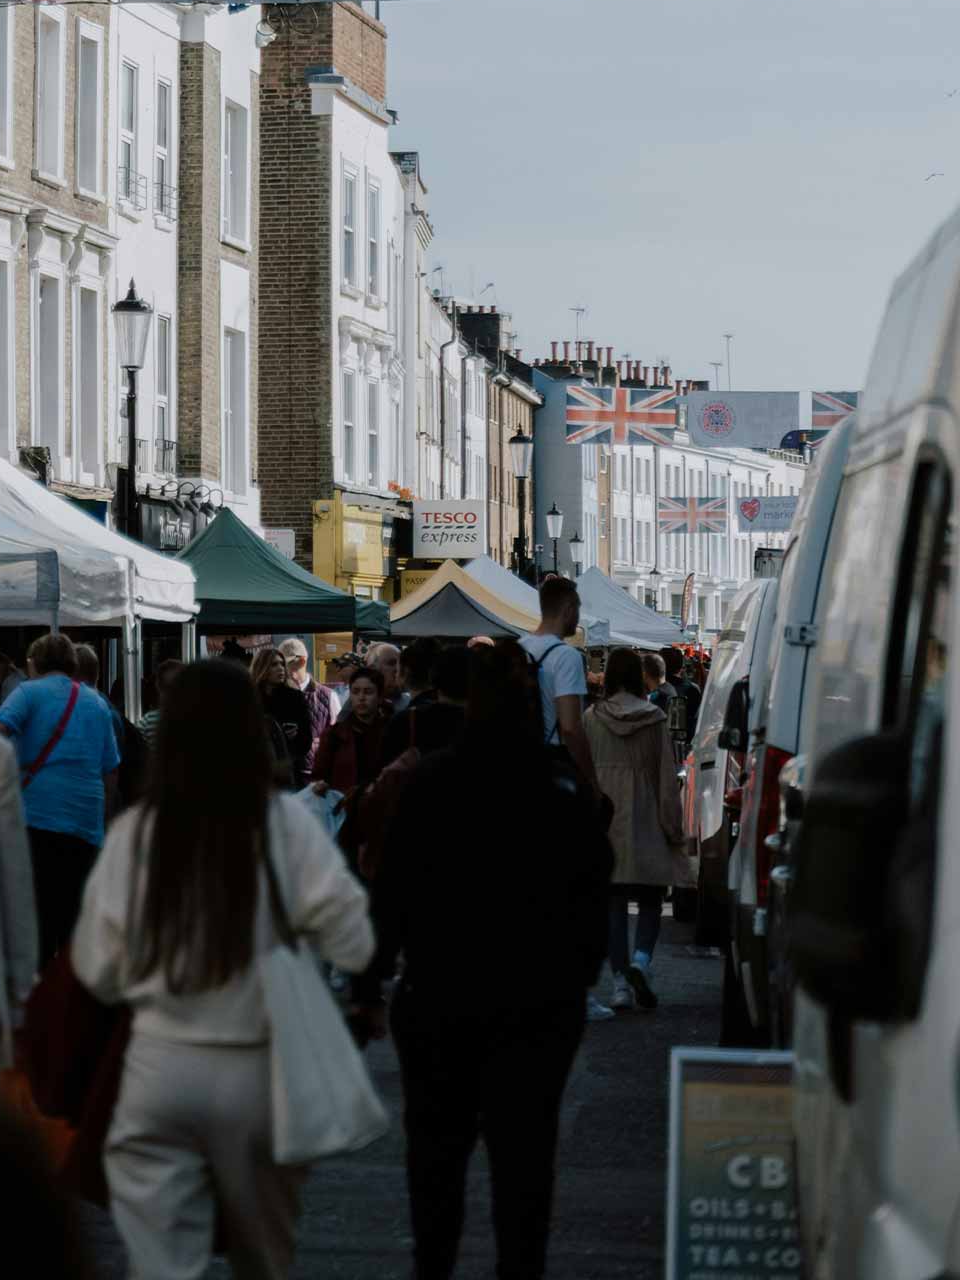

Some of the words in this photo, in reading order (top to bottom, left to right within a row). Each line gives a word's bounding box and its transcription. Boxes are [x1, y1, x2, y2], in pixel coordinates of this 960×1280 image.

[422, 512, 477, 523] TESCO
[421, 531, 477, 546] express
[690, 1197, 748, 1218] OILS
[689, 1245, 739, 1266] TEA
